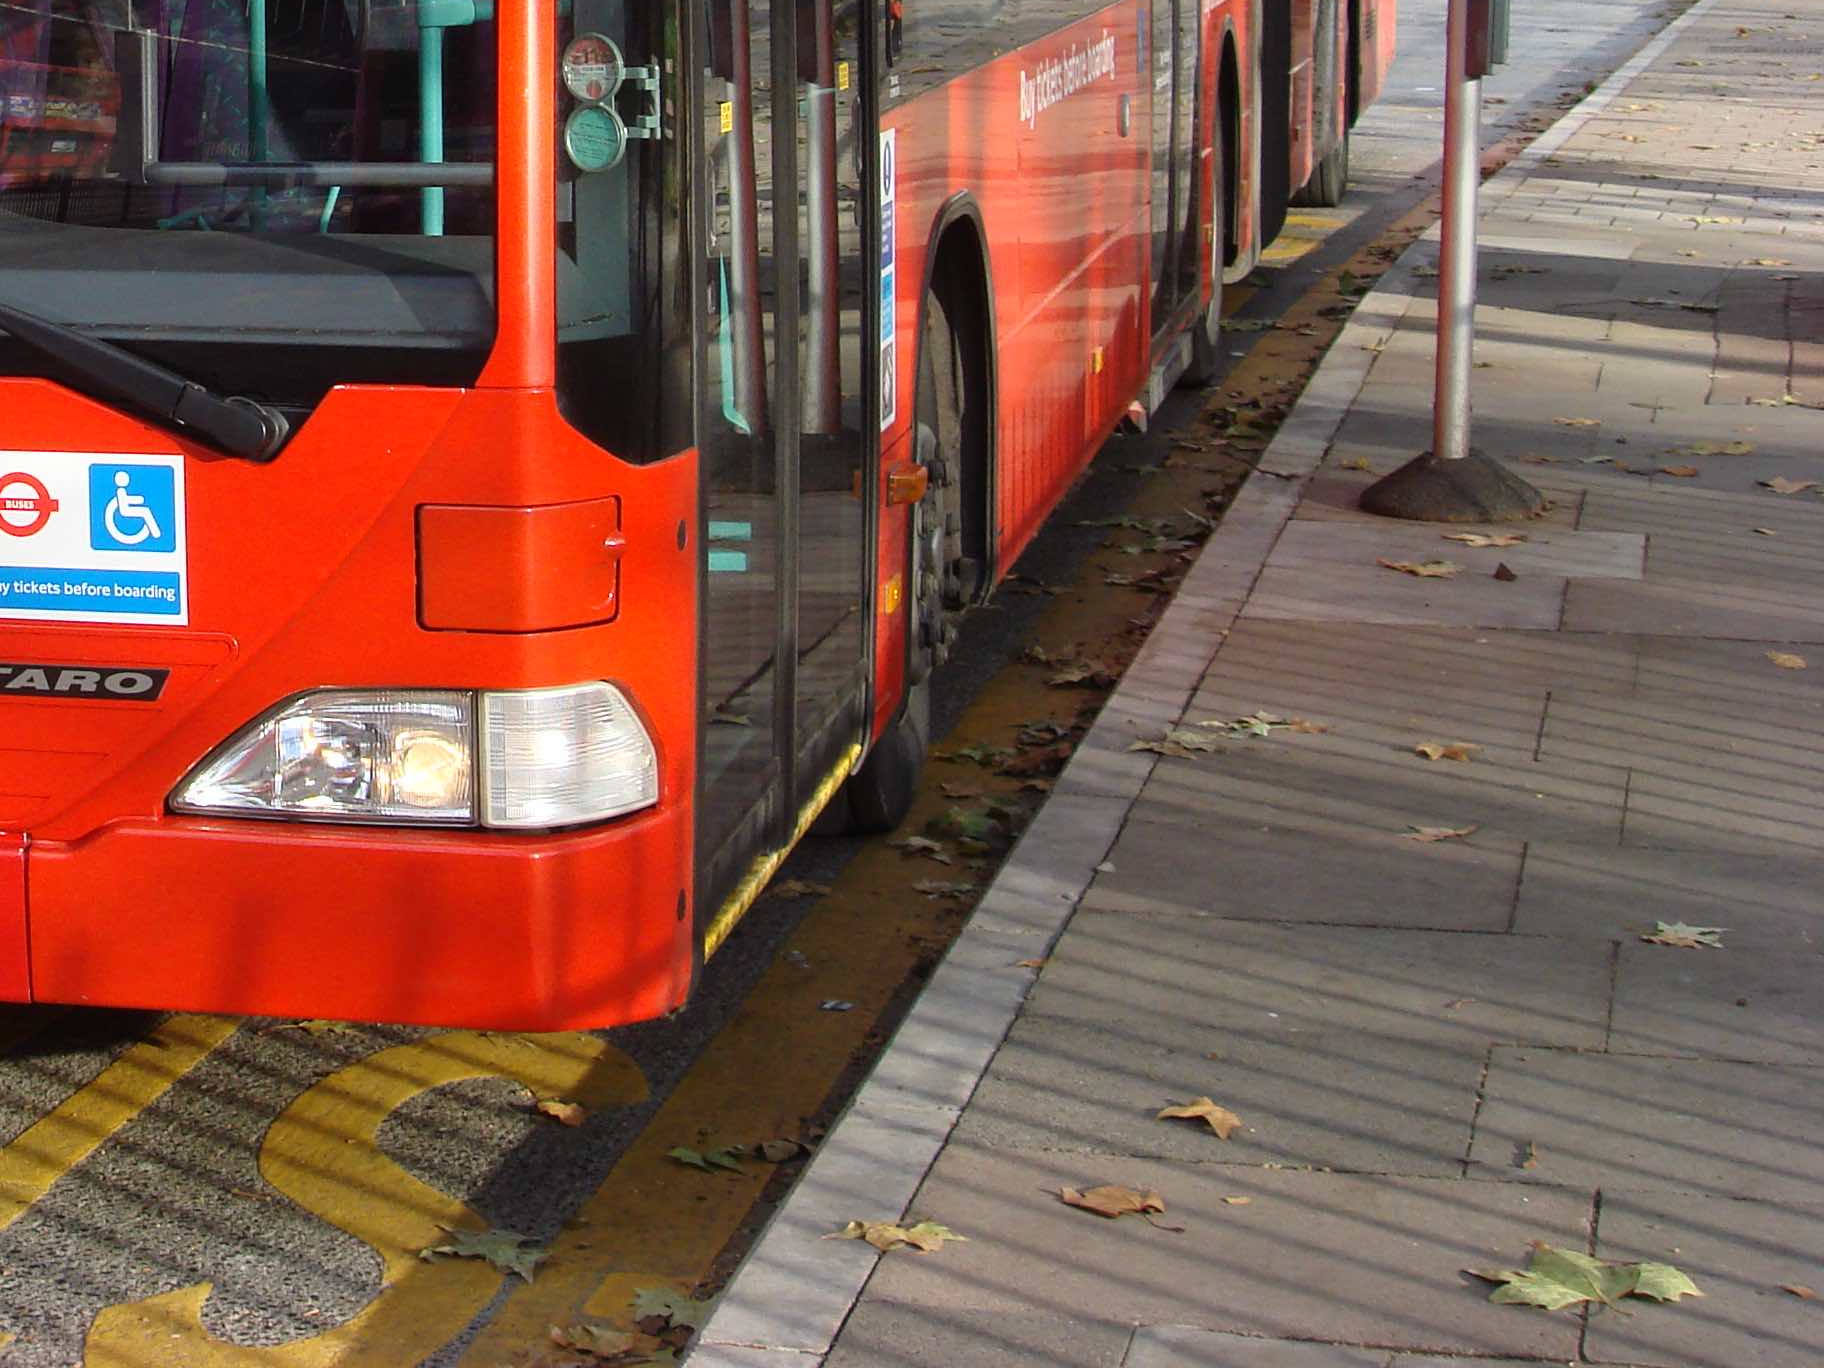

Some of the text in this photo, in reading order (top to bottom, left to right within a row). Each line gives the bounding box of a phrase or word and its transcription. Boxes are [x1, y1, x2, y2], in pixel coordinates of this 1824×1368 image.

[5, 499, 35, 509] BUSES
[13, 580, 61, 595] tickets
[63, 582, 111, 597] before
[113, 583, 176, 602] boarding
